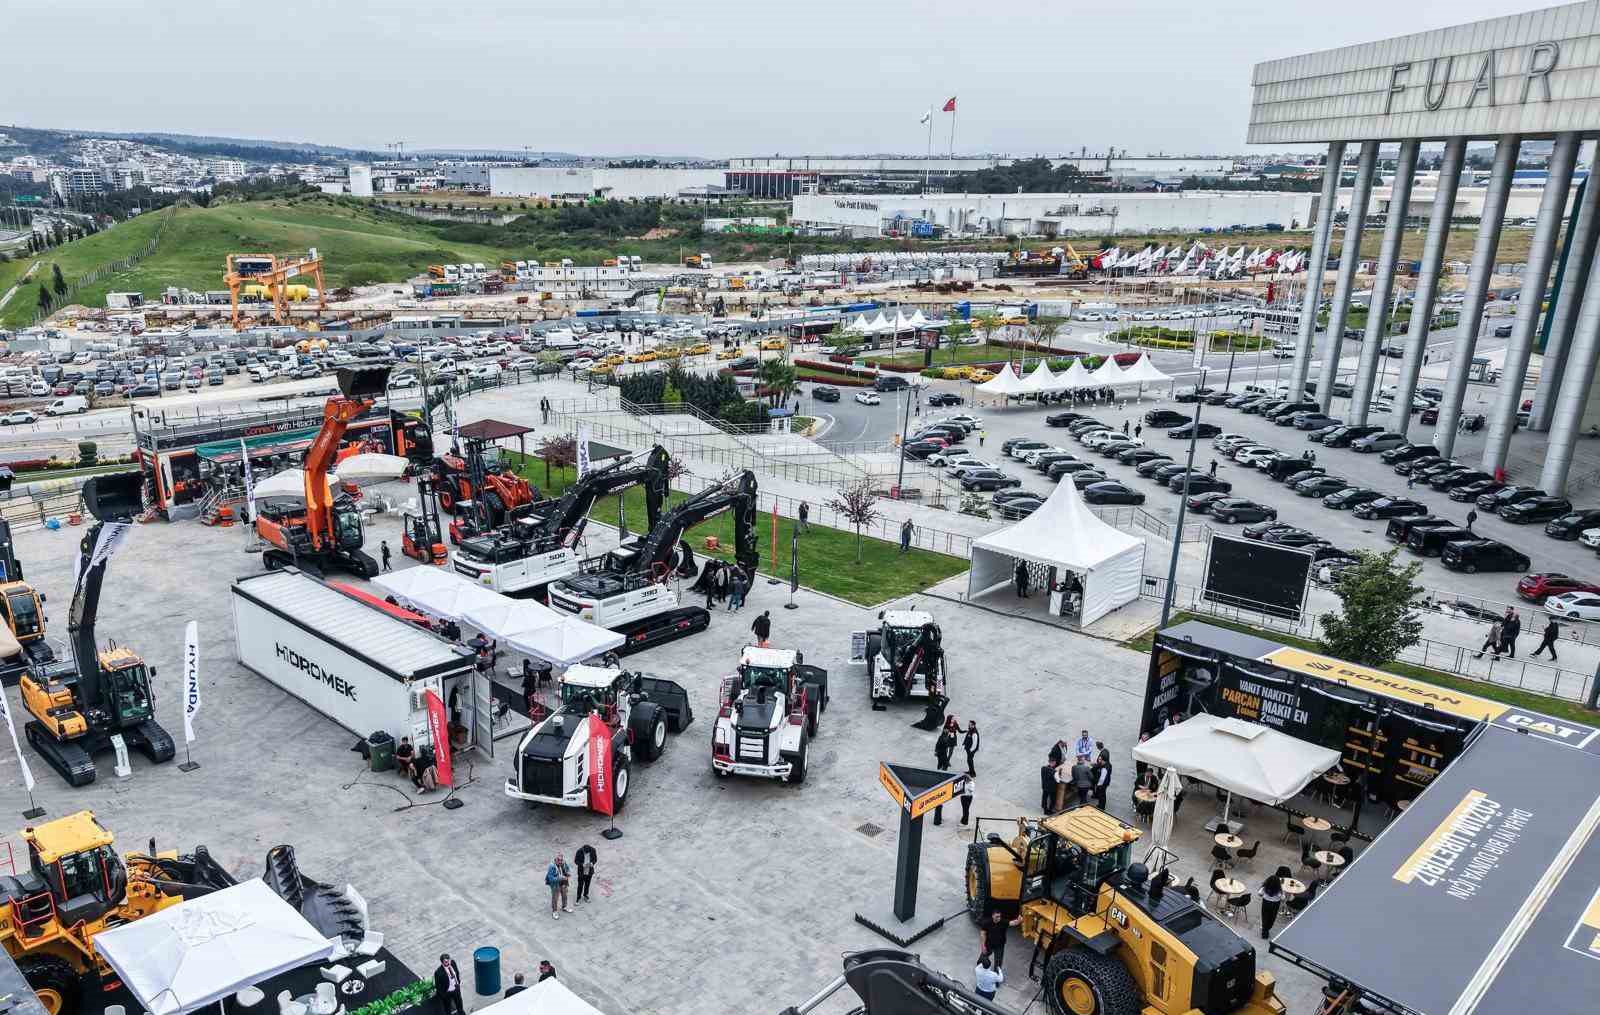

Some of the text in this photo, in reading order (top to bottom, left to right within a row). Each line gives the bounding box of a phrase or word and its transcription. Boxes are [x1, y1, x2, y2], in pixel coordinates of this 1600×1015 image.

[1384, 41, 1560, 115] FUAR
[277, 421, 292, 432] with
[293, 417, 318, 429] Hitachi
[1337, 669, 1462, 705] BORUSAN
[1260, 712, 1266, 723] 2
[1262, 699, 1309, 724] MAKİEN
[1506, 714, 1581, 738] CAT
[954, 780, 966, 794] CAT
[904, 796, 913, 814] CAT
[1500, 808, 1534, 832] DAHA
[1411, 831, 1478, 887] ÜRETİRİZ
[1460, 851, 1499, 881] DÜNYA
[1447, 876, 1482, 901] İÇİN
[1111, 907, 1127, 926] CAT
